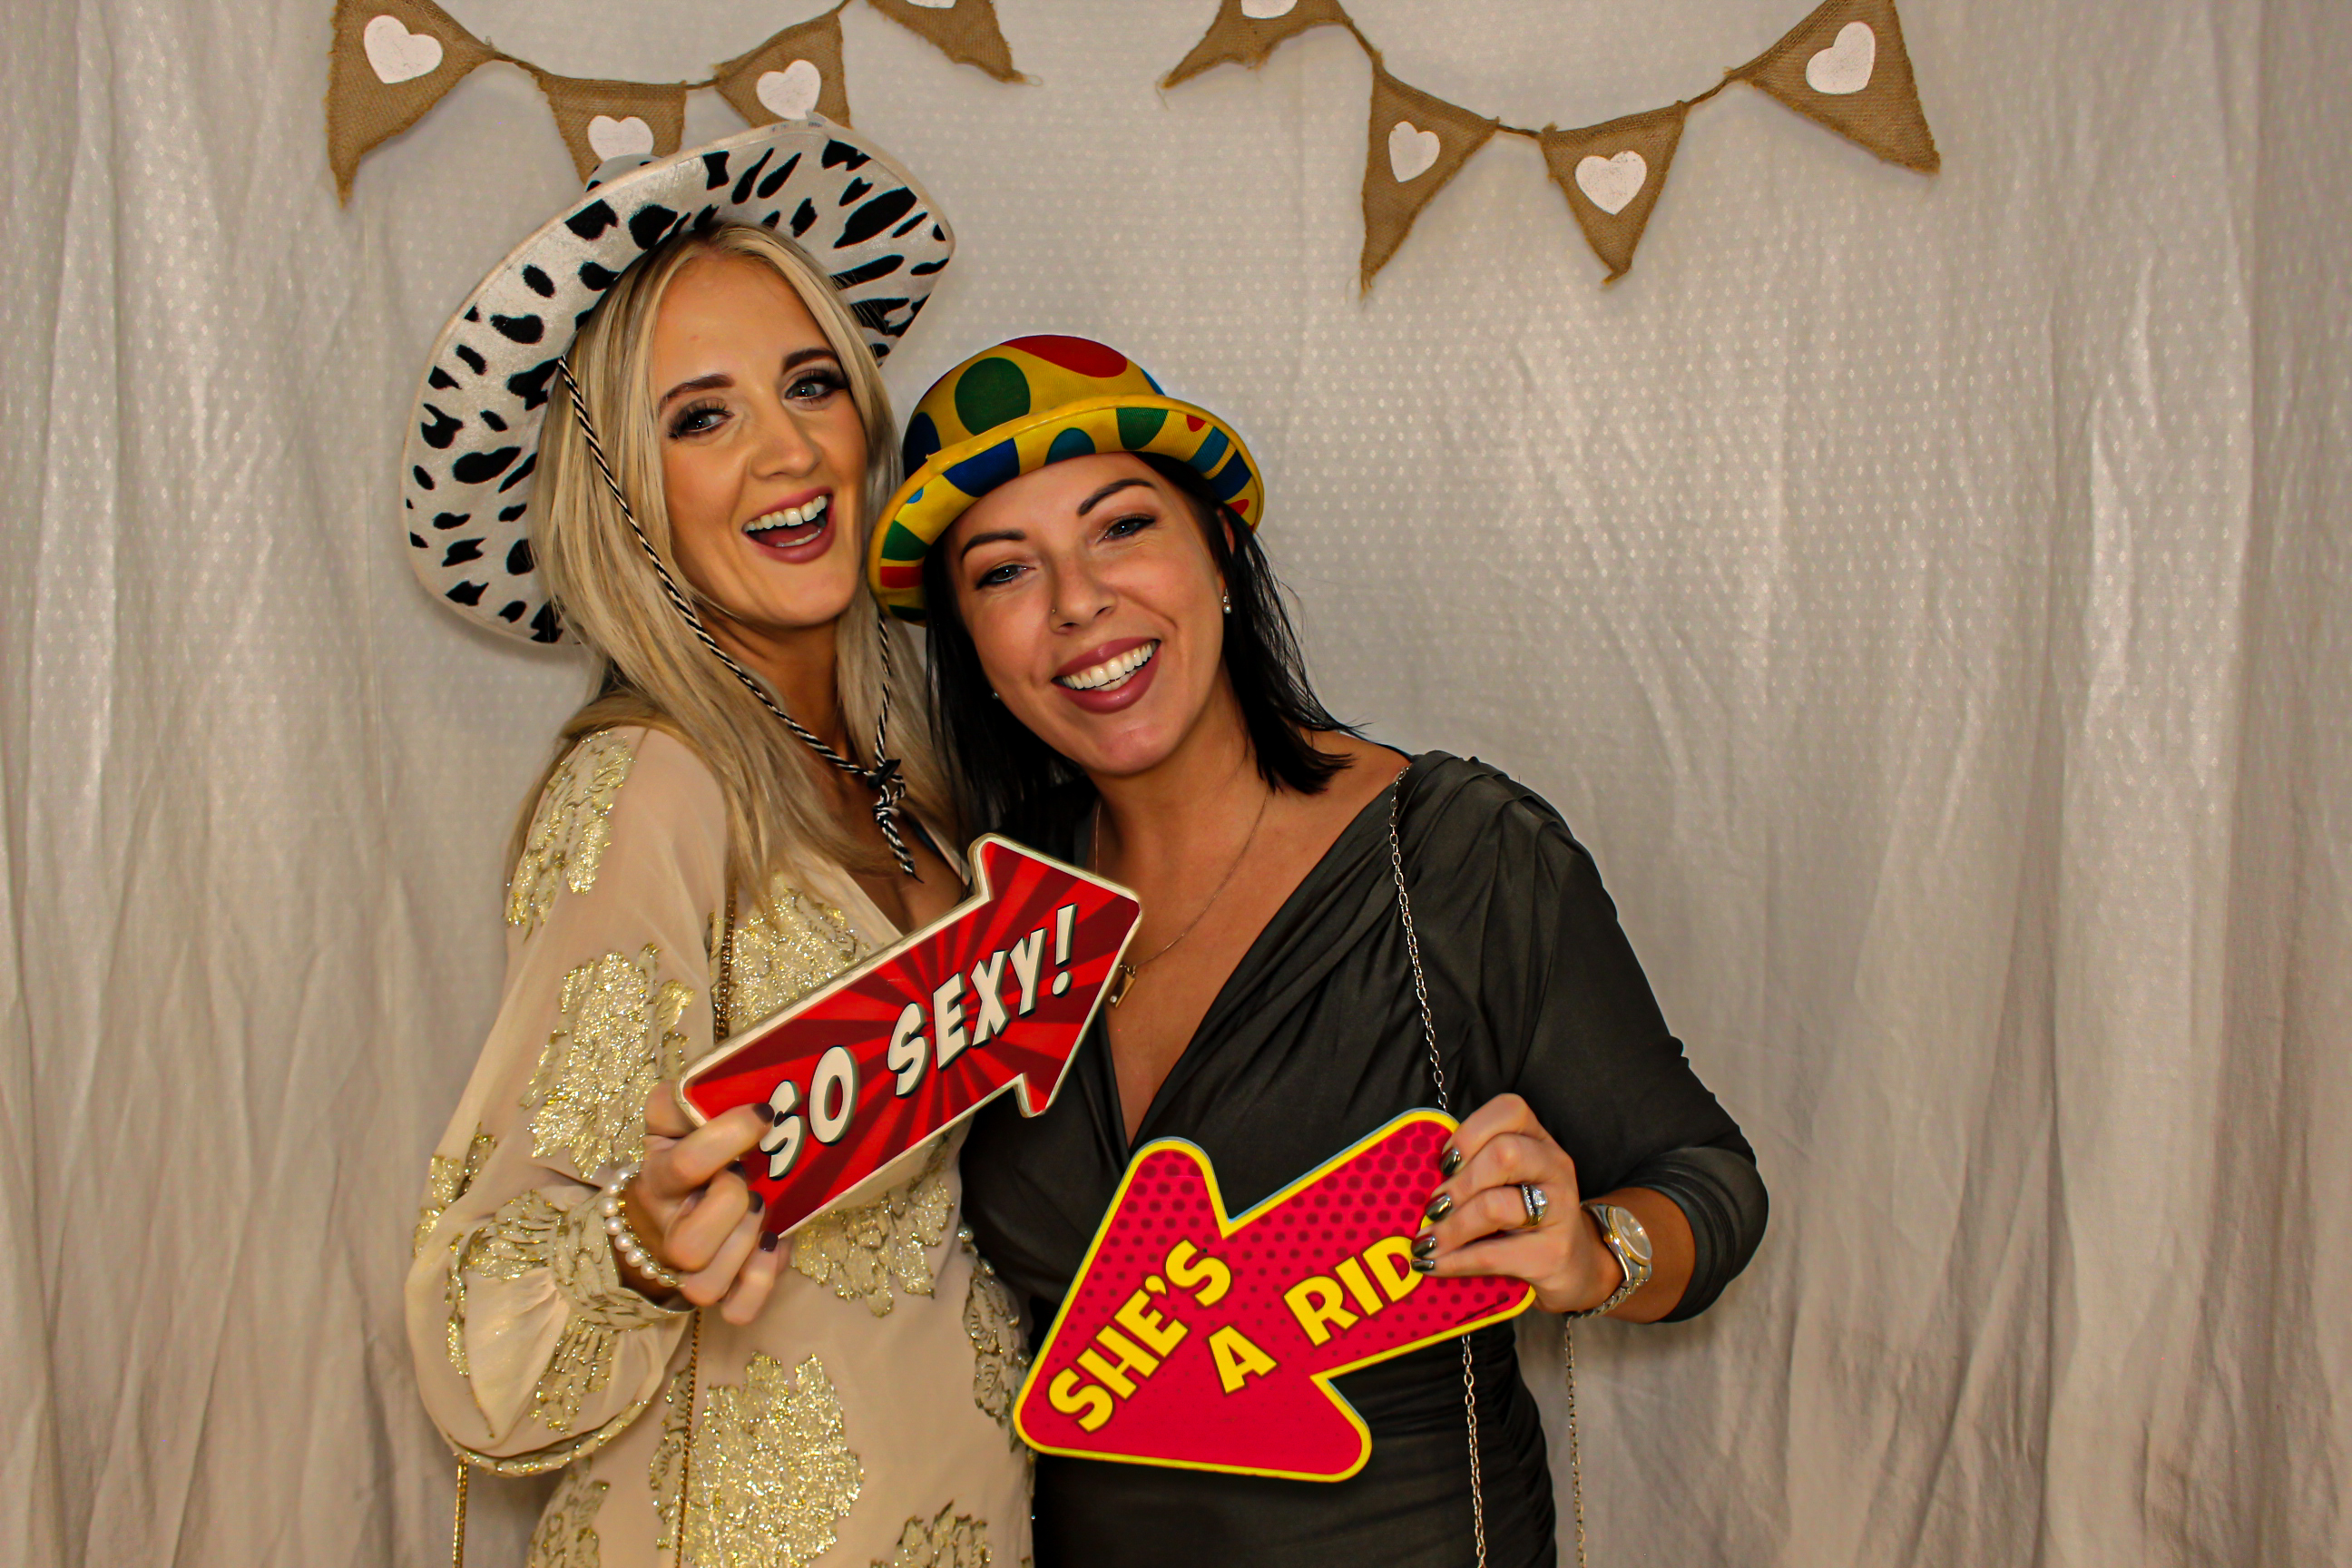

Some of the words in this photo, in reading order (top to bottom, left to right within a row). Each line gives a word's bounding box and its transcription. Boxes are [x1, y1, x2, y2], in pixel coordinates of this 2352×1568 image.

[759, 1045, 858, 1180] SO
[887, 903, 1077, 1097] SEXY!
[1048, 1240, 1231, 1434] SHE'S
[1208, 1325, 1278, 1395] A
[1283, 1236, 1425, 1348] RID
